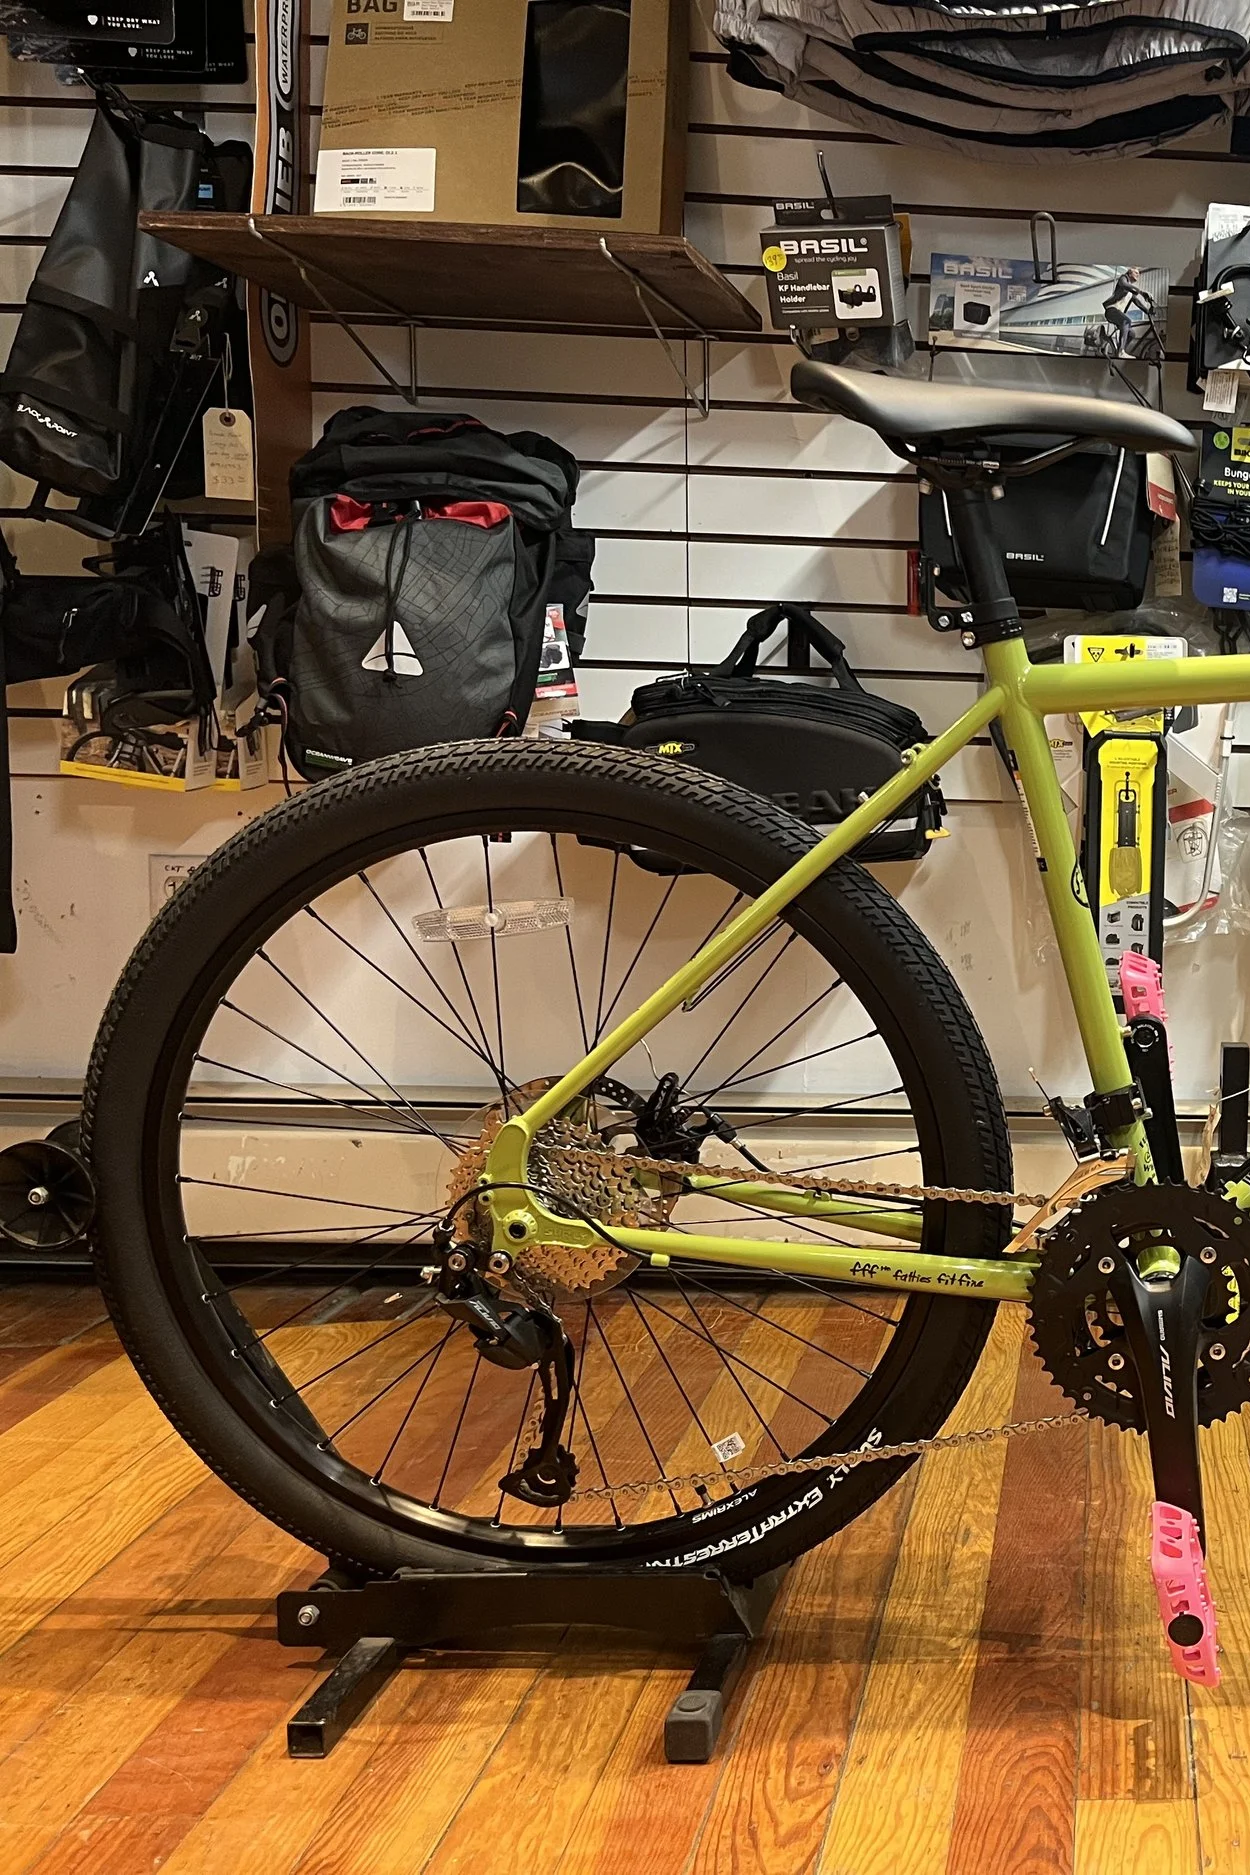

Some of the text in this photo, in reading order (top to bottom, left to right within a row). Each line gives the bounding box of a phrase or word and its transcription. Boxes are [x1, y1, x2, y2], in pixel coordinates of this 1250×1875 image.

[346, 0, 398, 14] BAG
[775, 201, 815, 210] BASIL
[777, 272, 799, 281] Basil
[943, 262, 1012, 279] BASIL
[790, 284, 830, 292] Handlebar
[1213, 479, 1233, 487] KEEPS
[1233, 481, 1250, 490] YOUR
[1235, 489, 1250, 497] YOUR
[1006, 551, 1044, 562] BASIL
[658, 742, 683, 755] MTX
[893, 1270, 932, 1284] fatties
[937, 1273, 956, 1286] fit
[957, 1273, 985, 1288] fine
[468, 1300, 501, 1331] ALIVIO
[1160, 1345, 1177, 1419] ALIVIO
[692, 1488, 758, 1524] ALEXRIMS
